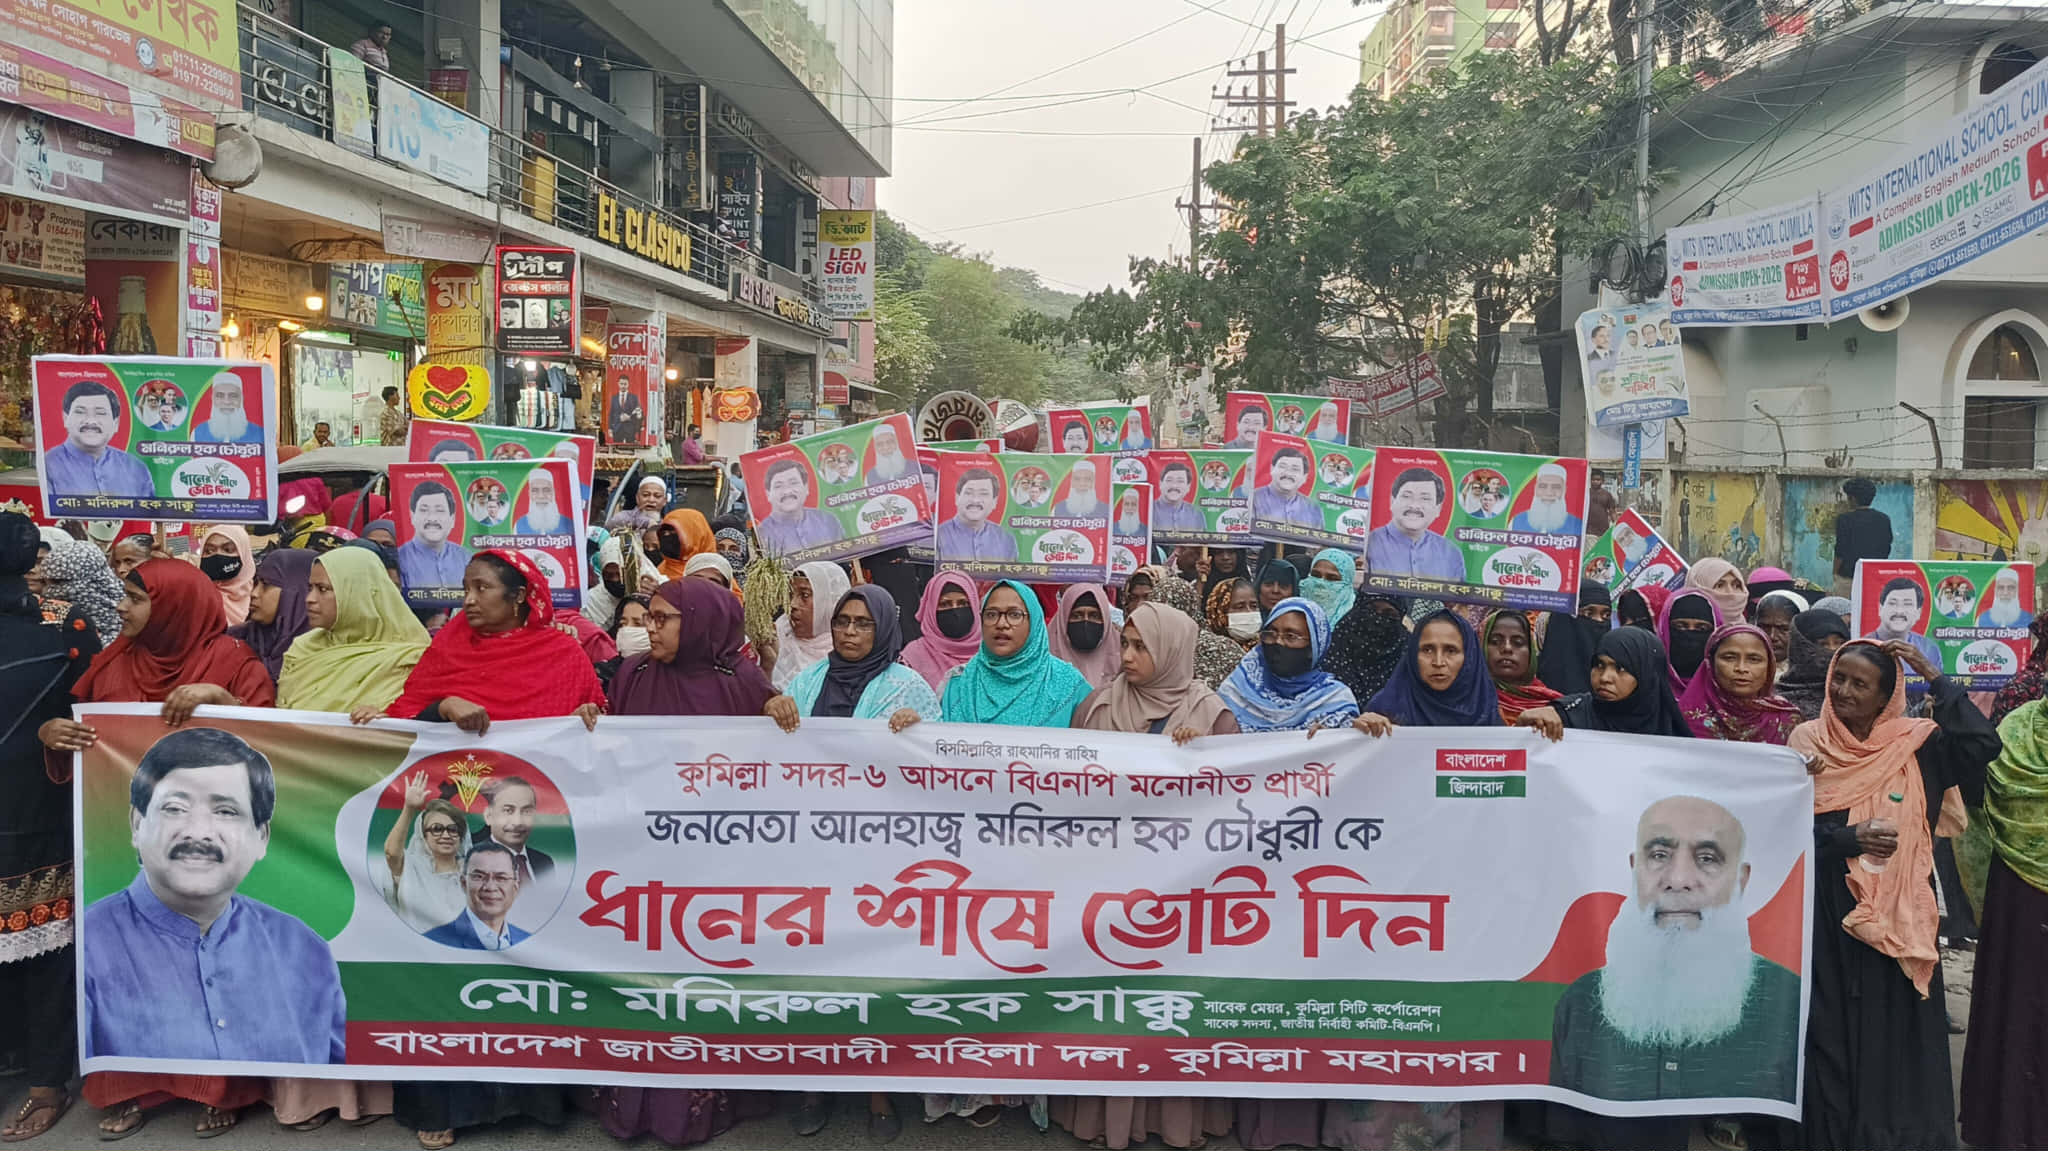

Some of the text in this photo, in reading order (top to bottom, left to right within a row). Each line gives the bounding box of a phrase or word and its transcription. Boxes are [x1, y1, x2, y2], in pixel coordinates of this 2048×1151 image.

[1875, 135, 1959, 207] INTERNATIONAL
[1883, 191, 1922, 220] Complete
[1924, 171, 1959, 199] English
[1960, 147, 2000, 177] Medium
[2002, 120, 2041, 154] School
[1878, 155, 2022, 252] ADMISSION OPEN-2026
[598, 193, 692, 273] EL CLÁSICO
[1698, 230, 1746, 256] INTERNATIONAL
[1779, 211, 1814, 243] CUMILLA
[829, 247, 863, 261] LED
[1704, 259, 1726, 270] Complete
[1727, 257, 1747, 269] English
[1748, 253, 1769, 264] Medium
[1770, 248, 1792, 260] School
[1699, 264, 1783, 290] ADMISSION OPEN-2026
[1792, 262, 1809, 275] Play
[1797, 275, 1806, 284] to
[1788, 283, 1817, 299] A Level
[610, 330, 648, 351] দেশ
[140, 441, 262, 459] মনিরুল হক চৌধুরী
[179, 471, 211, 488] ধানের
[188, 484, 231, 498] ভোট দিন
[868, 485, 887, 499] হক
[86, 494, 135, 511] মনিরুল
[138, 499, 162, 511] হক
[166, 499, 196, 514] সাক্কু
[1011, 516, 1107, 530] মনিরুল হক চৌধুরী
[472, 535, 573, 551] মনিরুল হক চৌধুরী
[1038, 540, 1064, 554] ধানের
[1458, 528, 1578, 550] মনিরুল হক চৌধুরী
[1044, 553, 1064, 562] ভোট
[963, 561, 1050, 576] মনিরুল হক সাক্কু
[1491, 559, 1549, 578] ধানের শীষে
[1397, 576, 1444, 593] মনিরুল
[1448, 585, 1471, 595] হক
[1474, 587, 1505, 602] সাক্কু
[1497, 573, 1541, 586] ভোট দিন
[1935, 627, 2030, 641] মনিরুল হক চৌধুরী
[1963, 653, 1988, 665] ধানের
[1968, 664, 1988, 674] ভোট
[935, 739, 1099, 762] বিসমিল্লাহির রাহমানির রাহিম
[1444, 752, 1507, 771] বাংলাদেশ
[676, 753, 1336, 799] কুমিল্লা সদর-৬ আসনে বিএনপি মনোনীত প্রার্থী
[1448, 777, 1506, 797] জিন্দাবাদ
[644, 799, 1385, 862] জননেতা আলহাজ্ব মনিরুল হক চৌধুরী কে
[578, 858, 1451, 974] ধানের শীষে ভোট দিন
[612, 975, 881, 1026] মনিরুল
[895, 990, 1030, 1026] হক
[1043, 984, 1205, 1038] সাক্কু
[1203, 999, 1442, 1020] সাবেক মেয়র, কুমিল্লা সিটি কর্পোরেশন
[1203, 1017, 1241, 1031] সাবেক
[1281, 1016, 1315, 1032] জাতীয়
[1318, 1015, 1352, 1033] নির্বাহী
[369, 1029, 591, 1060] বাংলাদেশ
[599, 1034, 898, 1066] জাতীয়তাবাদী
[907, 1037, 1043, 1069] মহিলা
[1165, 1042, 1310, 1077] কুমিল্লা
[1321, 1048, 1503, 1076] মহানগর
